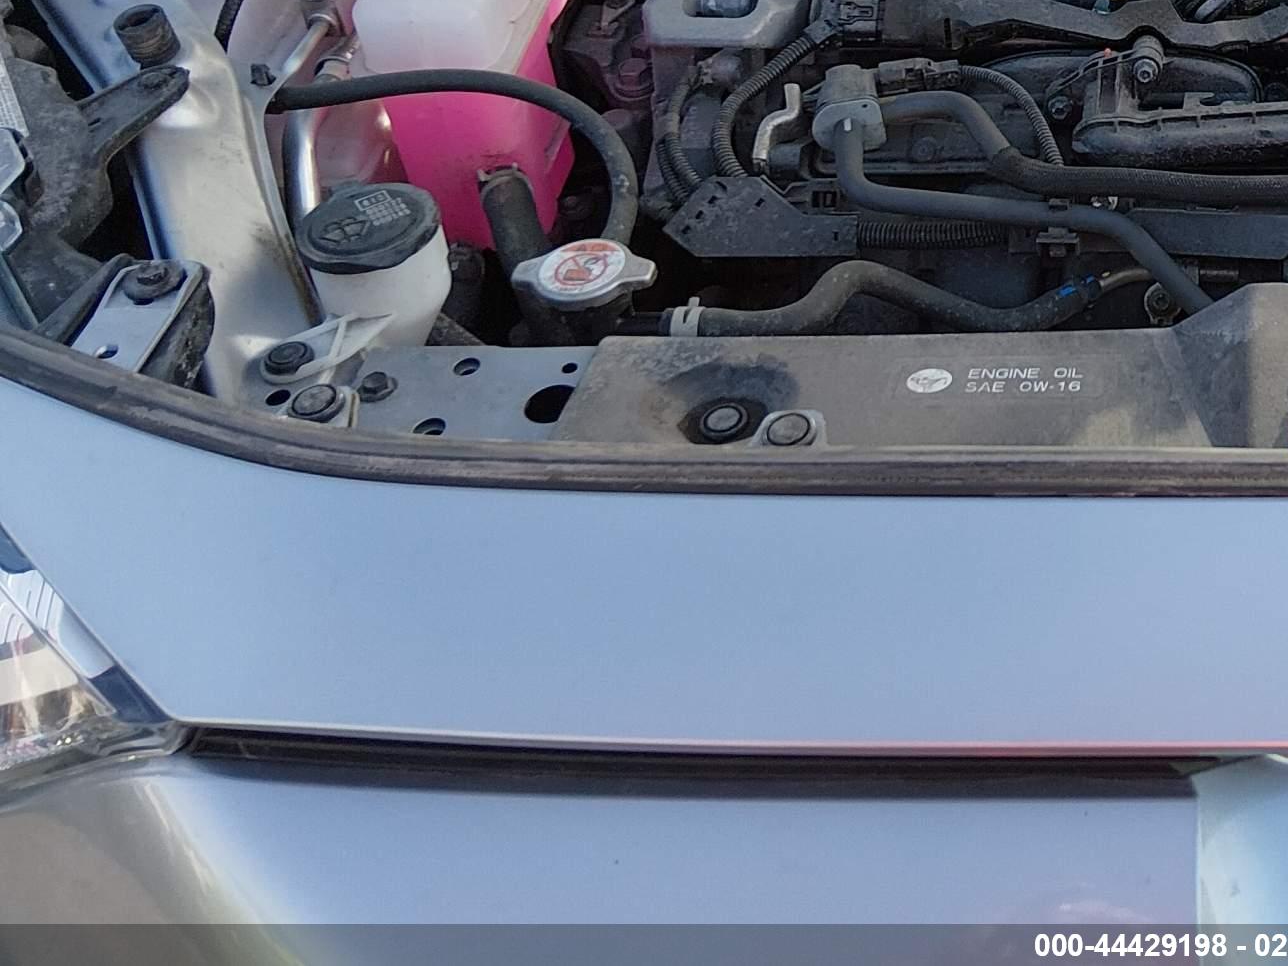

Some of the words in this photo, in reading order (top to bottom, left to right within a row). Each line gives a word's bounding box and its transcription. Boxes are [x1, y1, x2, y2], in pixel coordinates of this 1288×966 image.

[967, 367, 1041, 380] ENGINE
[1053, 367, 1084, 379] OIL
[964, 381, 1006, 393] SAE
